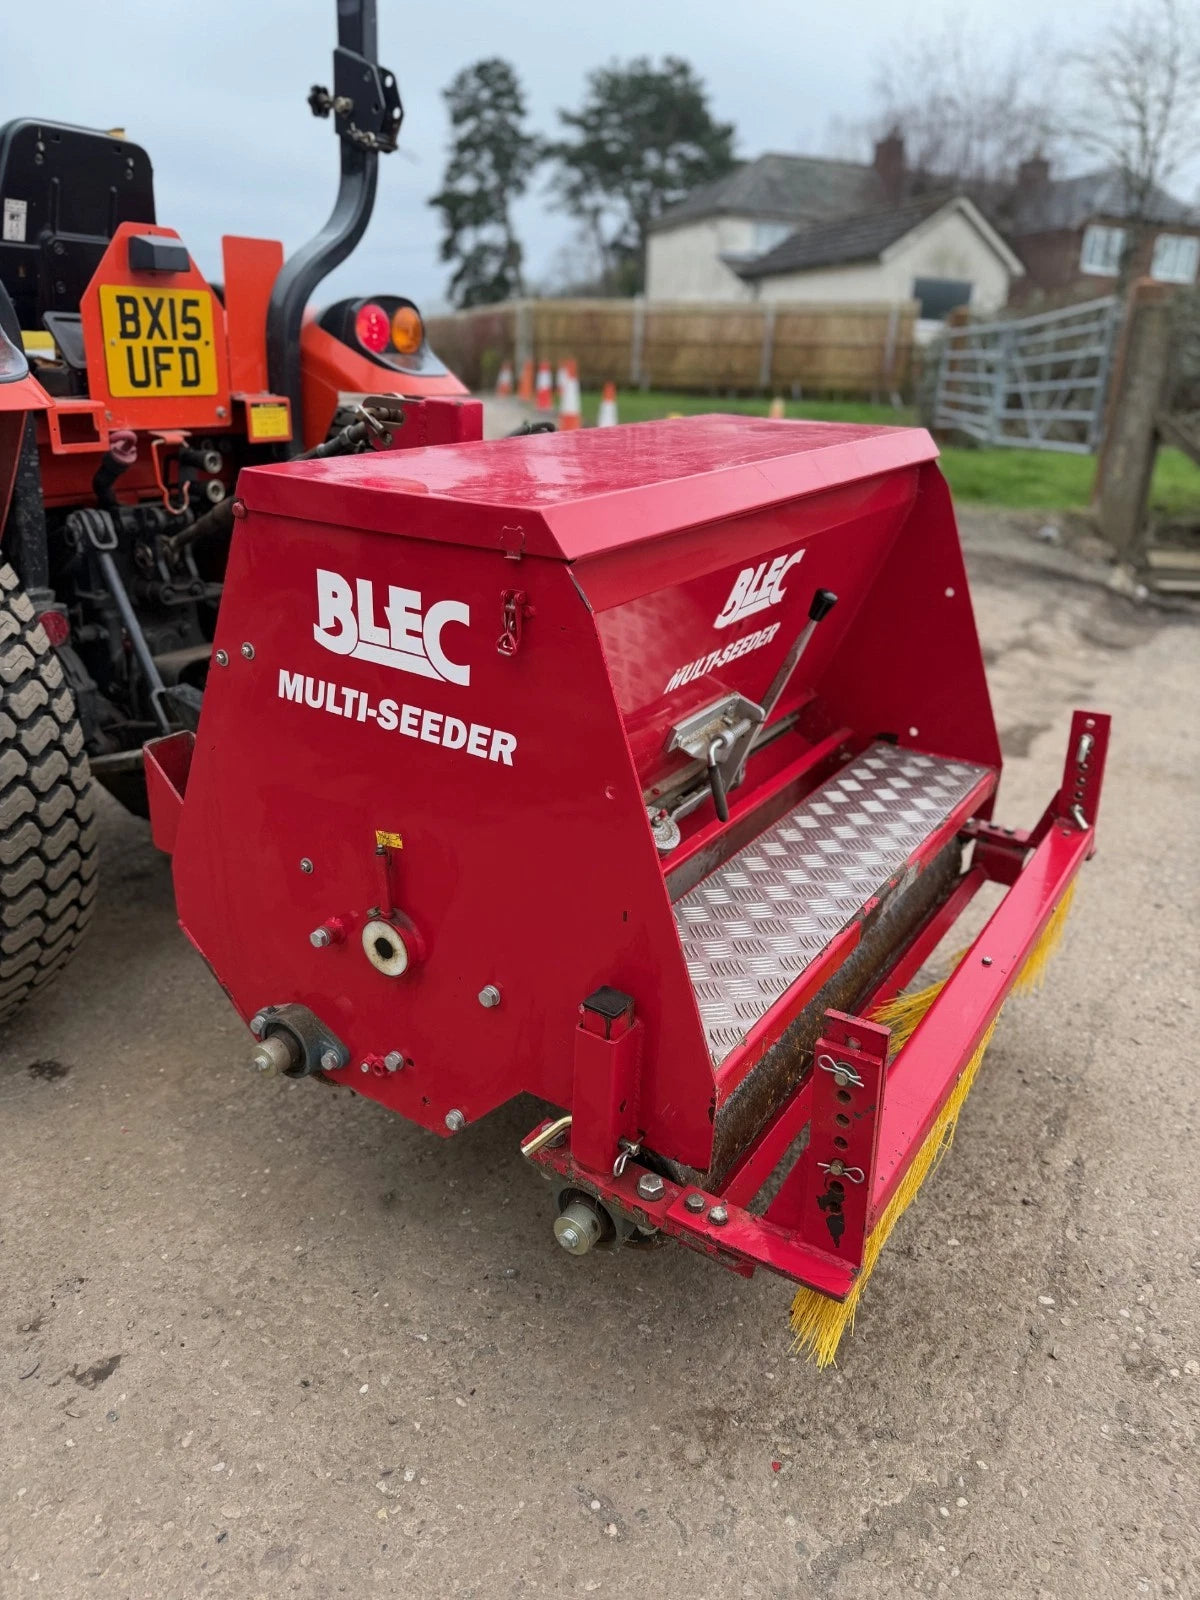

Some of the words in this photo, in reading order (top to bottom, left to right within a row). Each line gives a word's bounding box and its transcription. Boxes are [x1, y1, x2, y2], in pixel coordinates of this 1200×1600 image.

[115, 294, 201, 340] BX15
[126, 345, 201, 388] UFD
[313, 568, 470, 686] BLEC
[713, 548, 806, 629] BLEC
[663, 621, 781, 695] MULTI-SEEDER
[277, 668, 517, 766] MULTI-SEEDER
